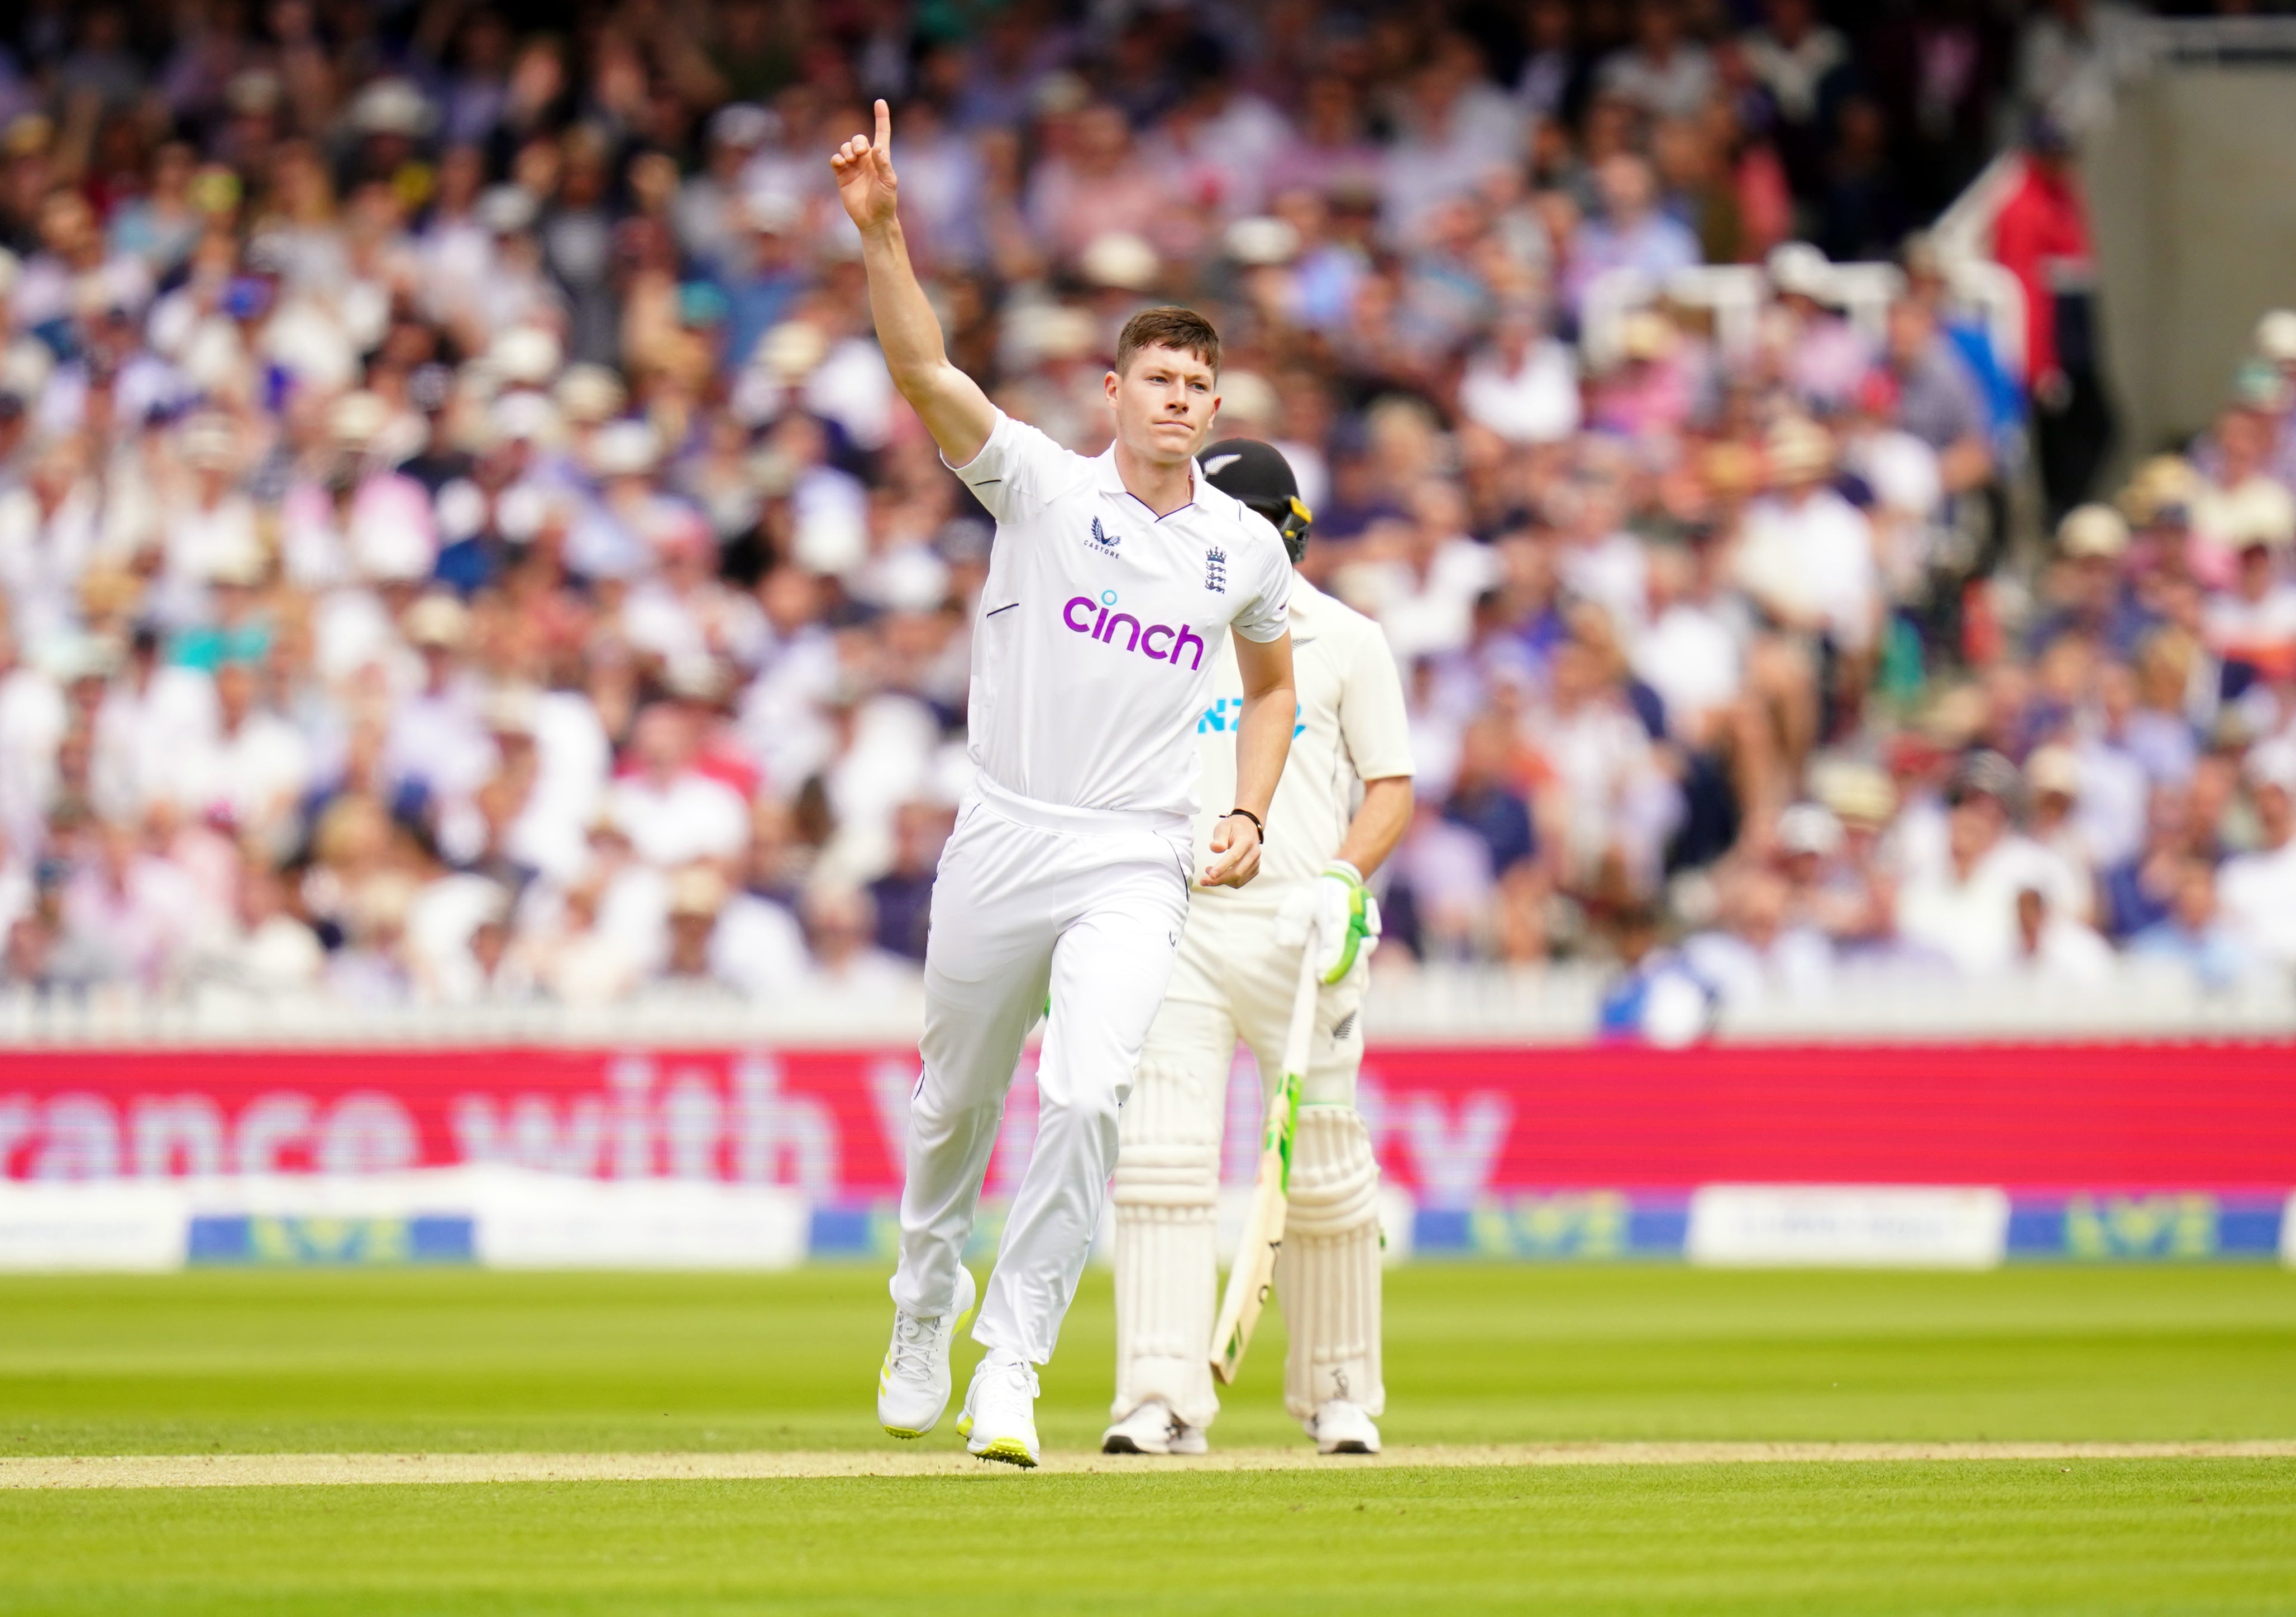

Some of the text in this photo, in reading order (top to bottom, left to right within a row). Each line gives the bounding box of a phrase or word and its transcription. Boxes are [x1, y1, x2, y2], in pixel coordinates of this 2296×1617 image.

[1083, 540, 1120, 559] CASTORE
[1063, 590, 1204, 671] cinch
[451, 1053, 838, 1195] with
